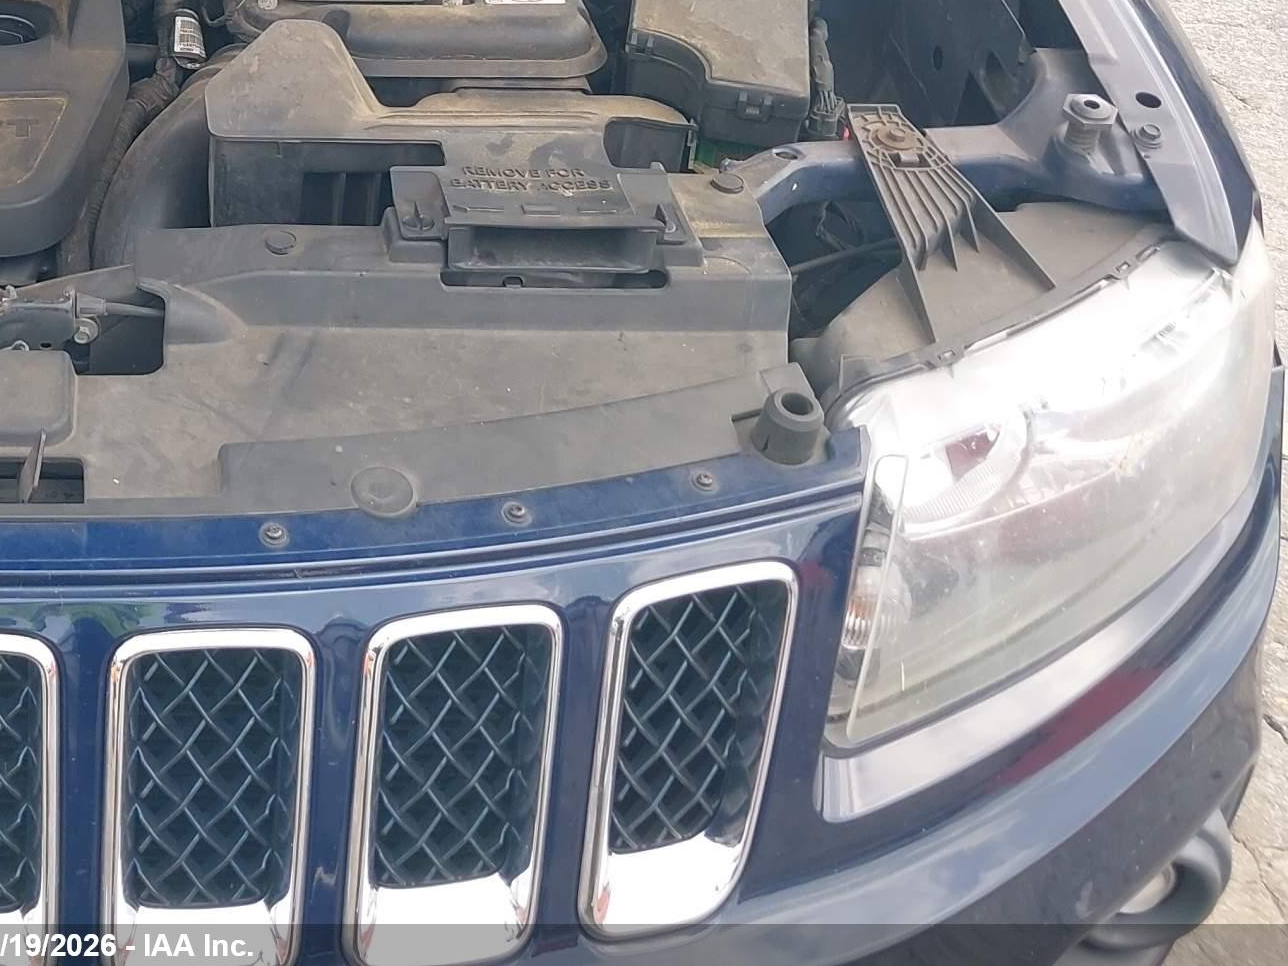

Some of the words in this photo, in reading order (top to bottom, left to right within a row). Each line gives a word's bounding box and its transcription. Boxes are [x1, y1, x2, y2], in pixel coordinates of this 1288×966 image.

[463, 166, 541, 179] REMOVE
[545, 168, 585, 178] FOR
[450, 178, 528, 191] BATTERY
